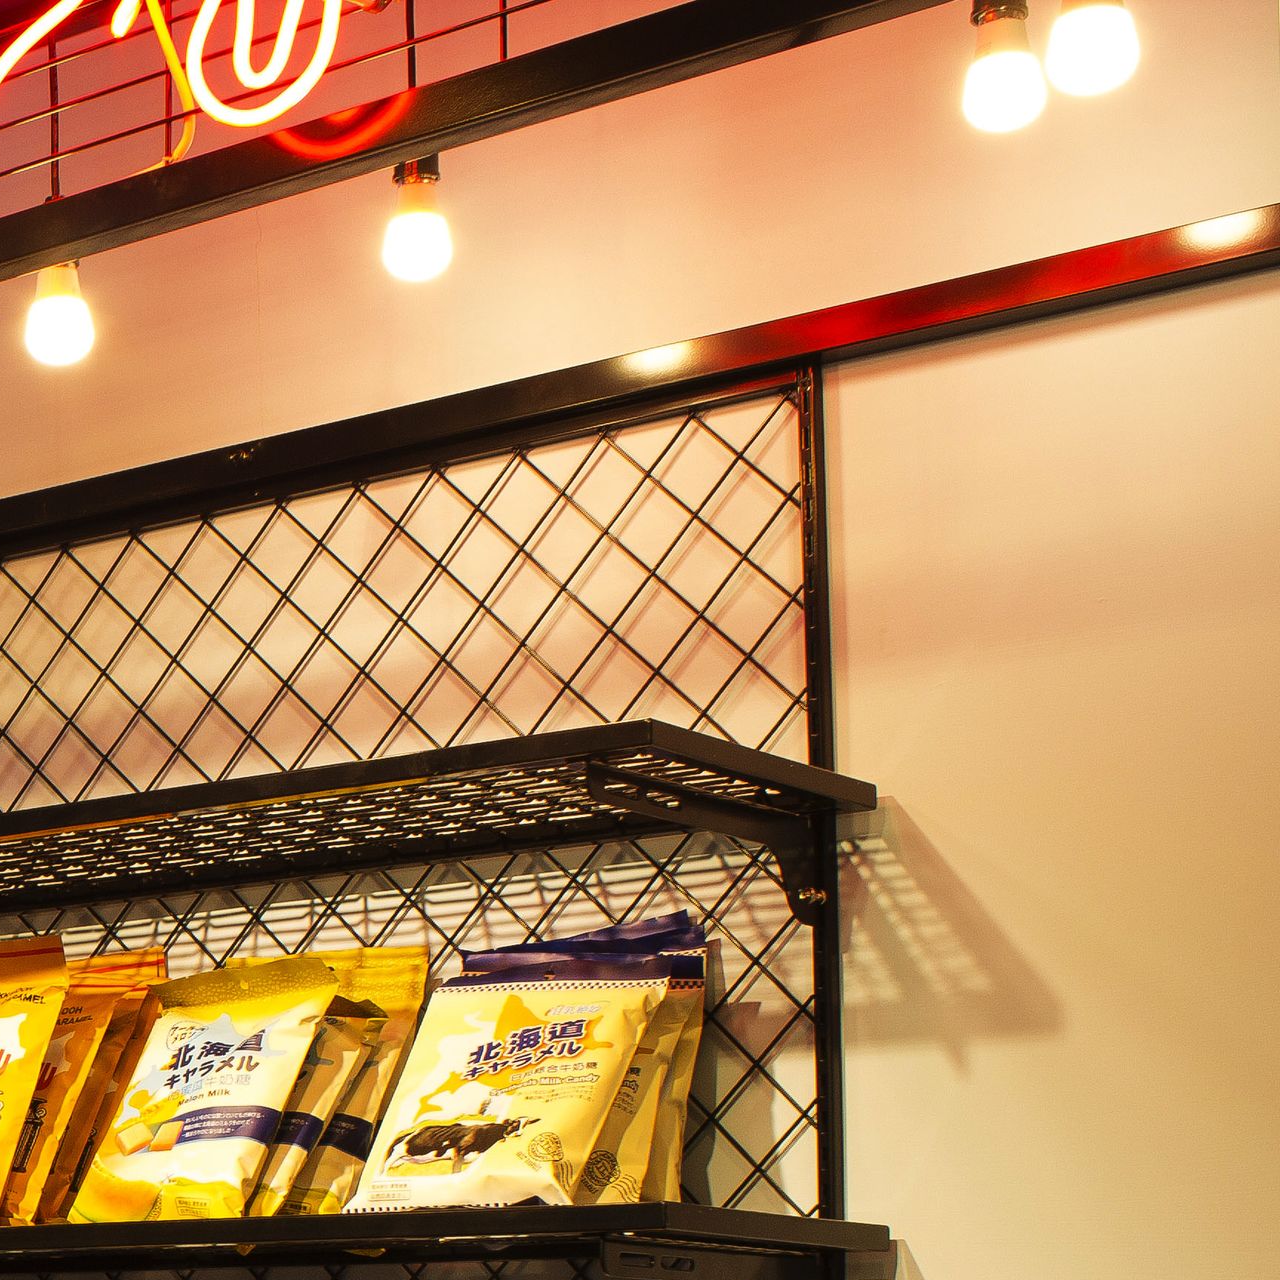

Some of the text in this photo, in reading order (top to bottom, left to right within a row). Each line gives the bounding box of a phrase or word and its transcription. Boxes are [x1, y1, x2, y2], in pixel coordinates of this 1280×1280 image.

[464, 1040, 585, 1080] キャラメル
[469, 1018, 588, 1065] 北海道
[163, 1054, 260, 1090] キャラメル
[208, 1088, 231, 1098] Milk
